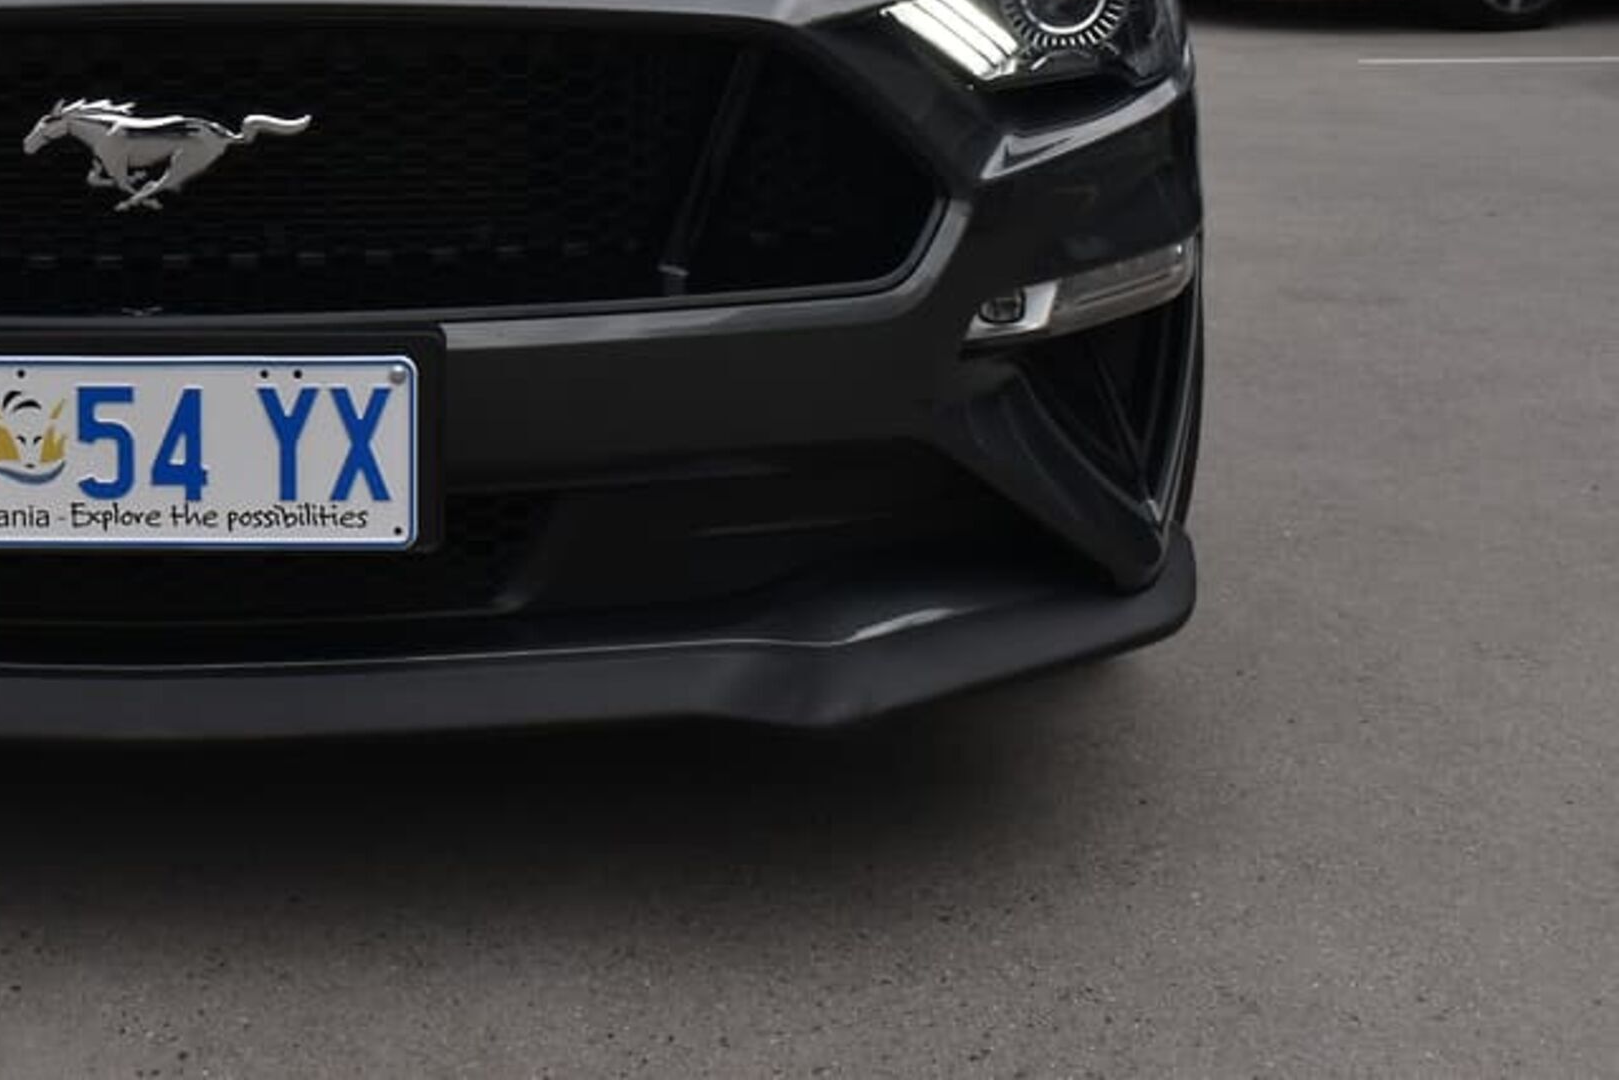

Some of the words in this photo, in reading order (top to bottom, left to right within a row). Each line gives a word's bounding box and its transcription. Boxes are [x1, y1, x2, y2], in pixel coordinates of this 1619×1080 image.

[77, 387, 208, 502] 54
[257, 387, 392, 501] YX
[71, 501, 162, 532] Explore
[171, 504, 218, 528] the
[227, 501, 368, 532] possibilities
